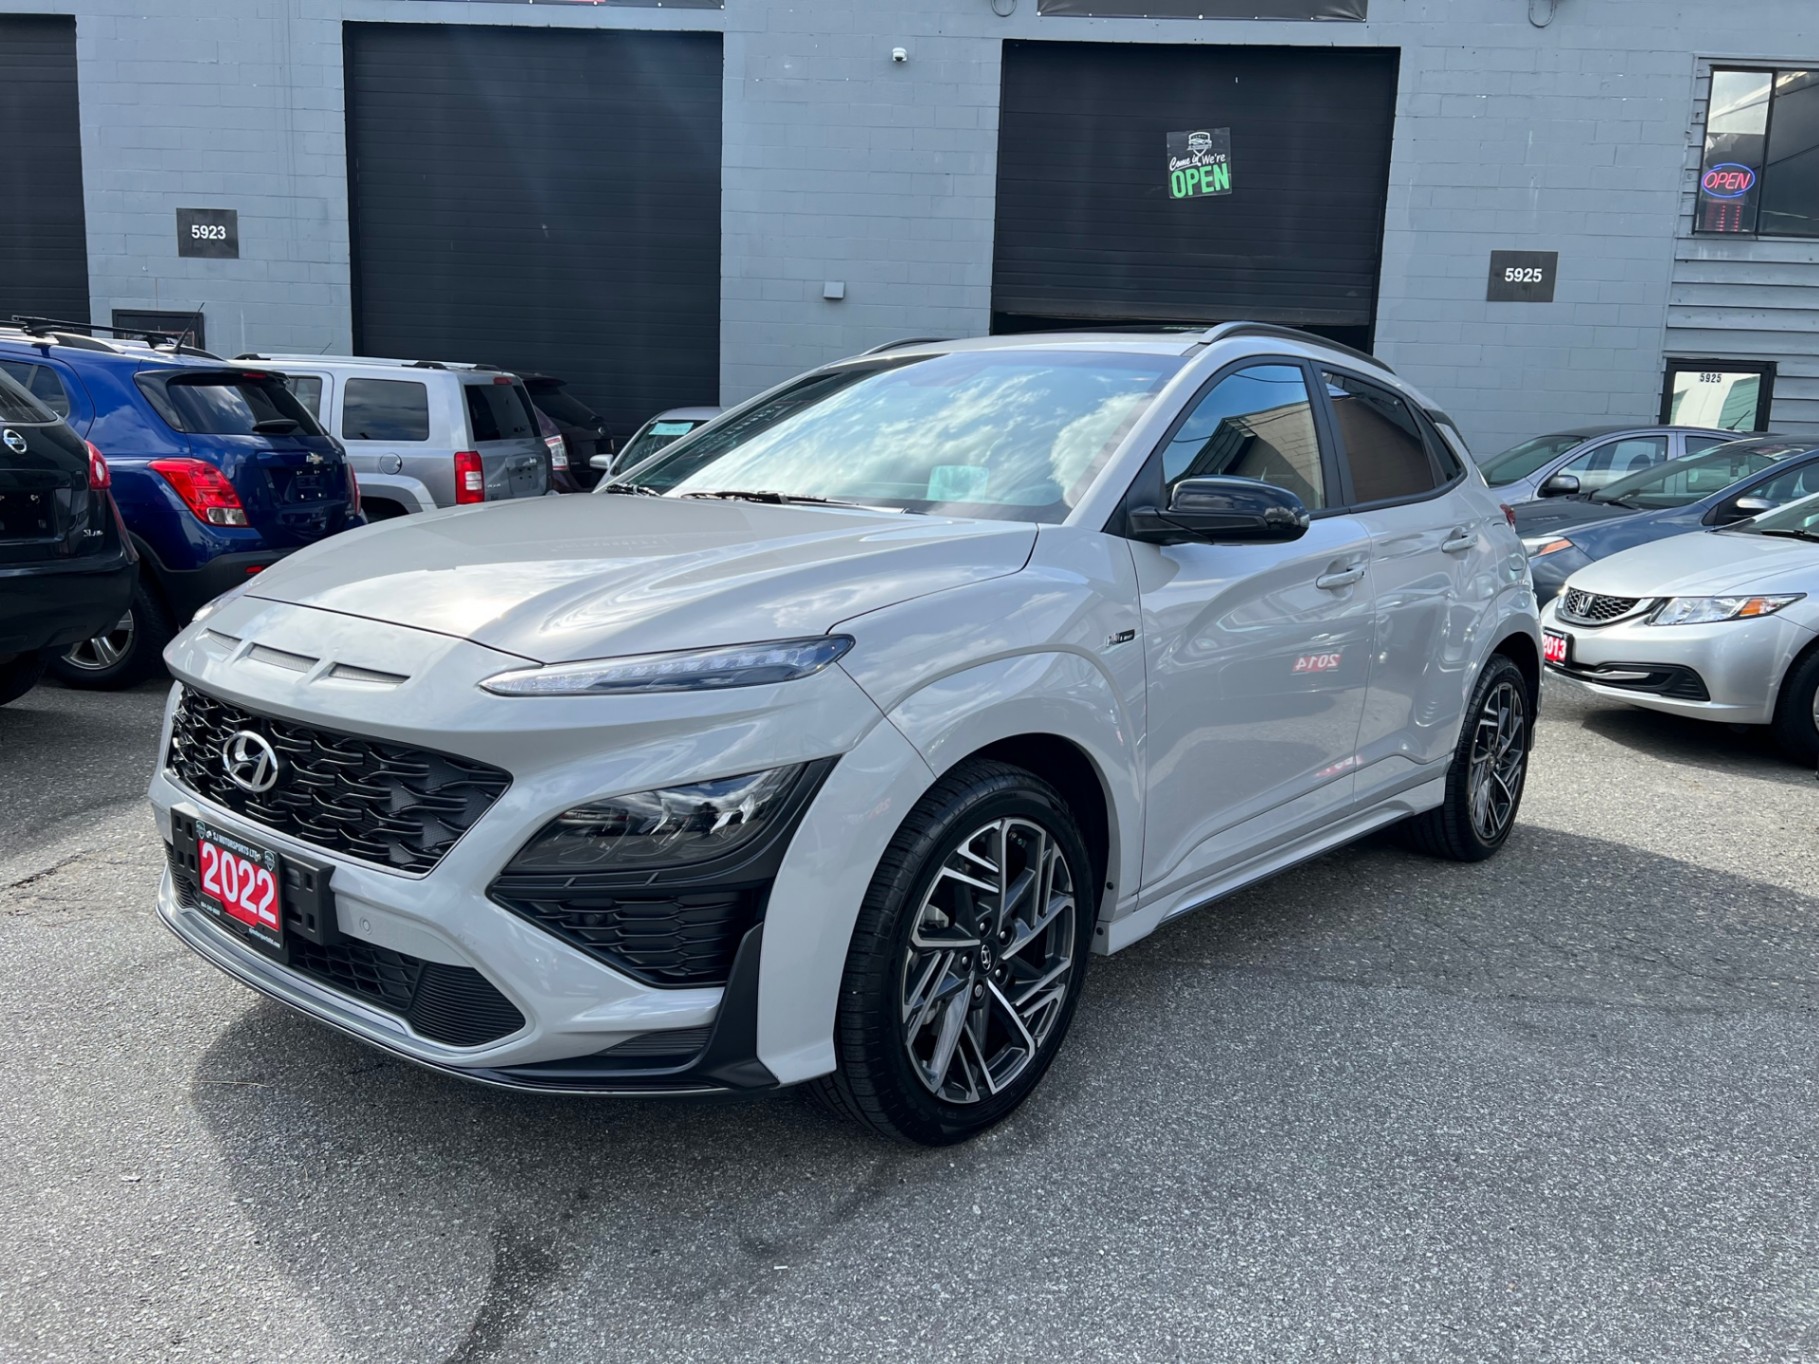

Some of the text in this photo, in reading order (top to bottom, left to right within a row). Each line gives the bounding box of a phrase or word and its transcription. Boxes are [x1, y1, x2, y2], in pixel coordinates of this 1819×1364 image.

[1169, 156, 1190, 171] Come
[1202, 153, 1226, 165] We're
[1171, 162, 1230, 198] OPEN
[1704, 172, 1751, 189] OPEN
[191, 224, 226, 240] 5923
[1504, 267, 1543, 283] 5925
[1699, 372, 1722, 383] 5925
[202, 841, 277, 925] 2022
